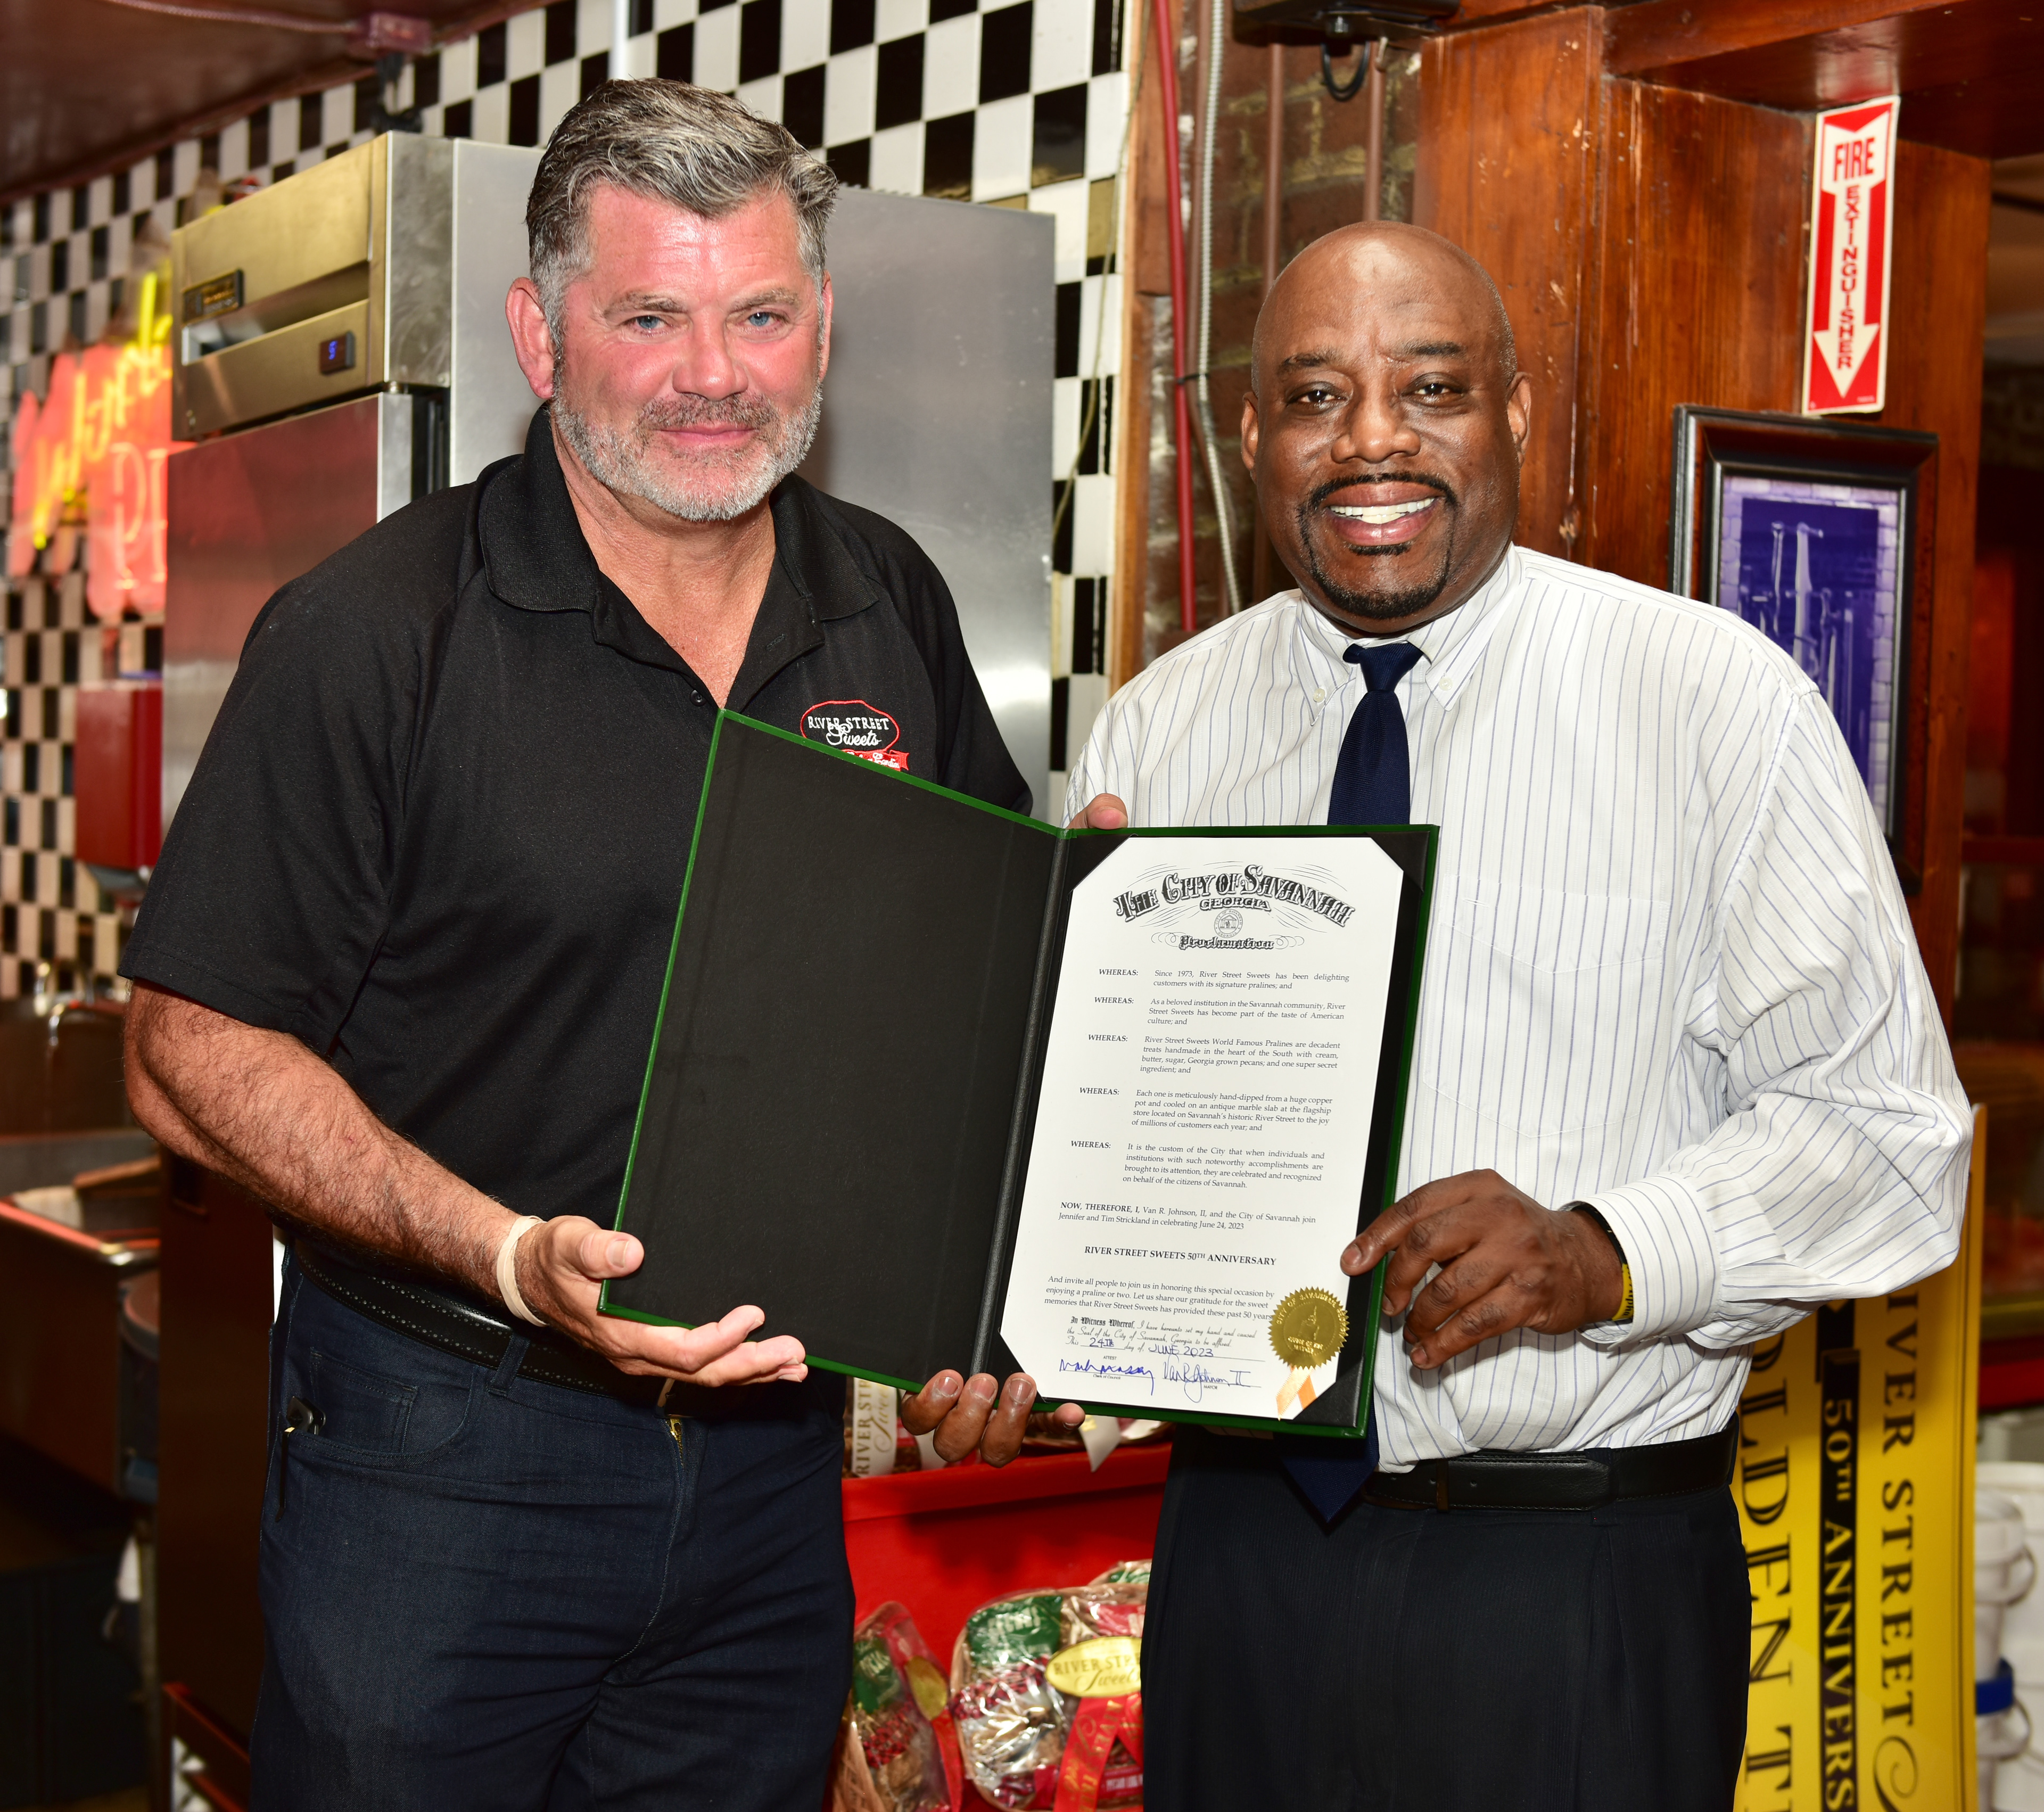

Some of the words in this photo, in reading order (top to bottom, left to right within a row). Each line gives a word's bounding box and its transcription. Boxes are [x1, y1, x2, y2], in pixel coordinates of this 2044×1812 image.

[1833, 137, 1875, 182] FIRE
[1837, 185, 1860, 370] EXTINGUISHER
[807, 716, 840, 729] RIVER
[845, 718, 889, 730] STREET
[826, 723, 882, 746] Sweets
[1161, 872, 1216, 904] CITY
[1240, 864, 1356, 928] SAVANNAH
[1199, 896, 1272, 911] GEORGIA
[1178, 935, 1275, 950] Proclamation
[1314, 973, 1349, 982] delighting
[1174, 1092, 1218, 1101] meticulously
[1219, 1093, 1264, 1102] hand-dipped
[1289, 1096, 1307, 1105] huge
[1060, 1201, 1082, 1210] NOW,
[1085, 1203, 1132, 1213] THEREFORE,
[1167, 1208, 1197, 1216] Johnson,
[1239, 1212, 1253, 1221] City
[1265, 1213, 1299, 1222] Savannah
[1160, 1218, 1197, 1229] celebrating
[1084, 1246, 1111, 1255] RIVER
[1114, 1248, 1148, 1257] STREET
[1149, 1250, 1185, 1259] SWEETS
[1207, 1254, 1276, 1265] ANNIVERSARY
[1127, 1281, 1140, 1289] join
[1160, 1283, 1192, 1294] honoring
[1080, 1316, 1106, 1326] Witness
[1145, 1321, 1158, 1330] have
[1160, 1322, 1182, 1332] hereunto
[1206, 1326, 1222, 1335] hand
[1077, 1326, 1093, 1336] Seal
[1114, 1329, 1126, 1340] City
[1136, 1331, 1167, 1342] Savannah,
[1170, 1333, 1192, 1346] Georgia
[1065, 1335, 1078, 1345] This
[1124, 1341, 1134, 1352] day
[1148, 1344, 1180, 1355] JUNE
[1183, 1346, 1214, 1357] 2023
[856, 1416, 872, 1475] RIVER
[1825, 1398, 1853, 1501] 50TH
[1881, 1478, 1914, 1726] STREET
[1053, 1658, 1100, 1675] RIVER
